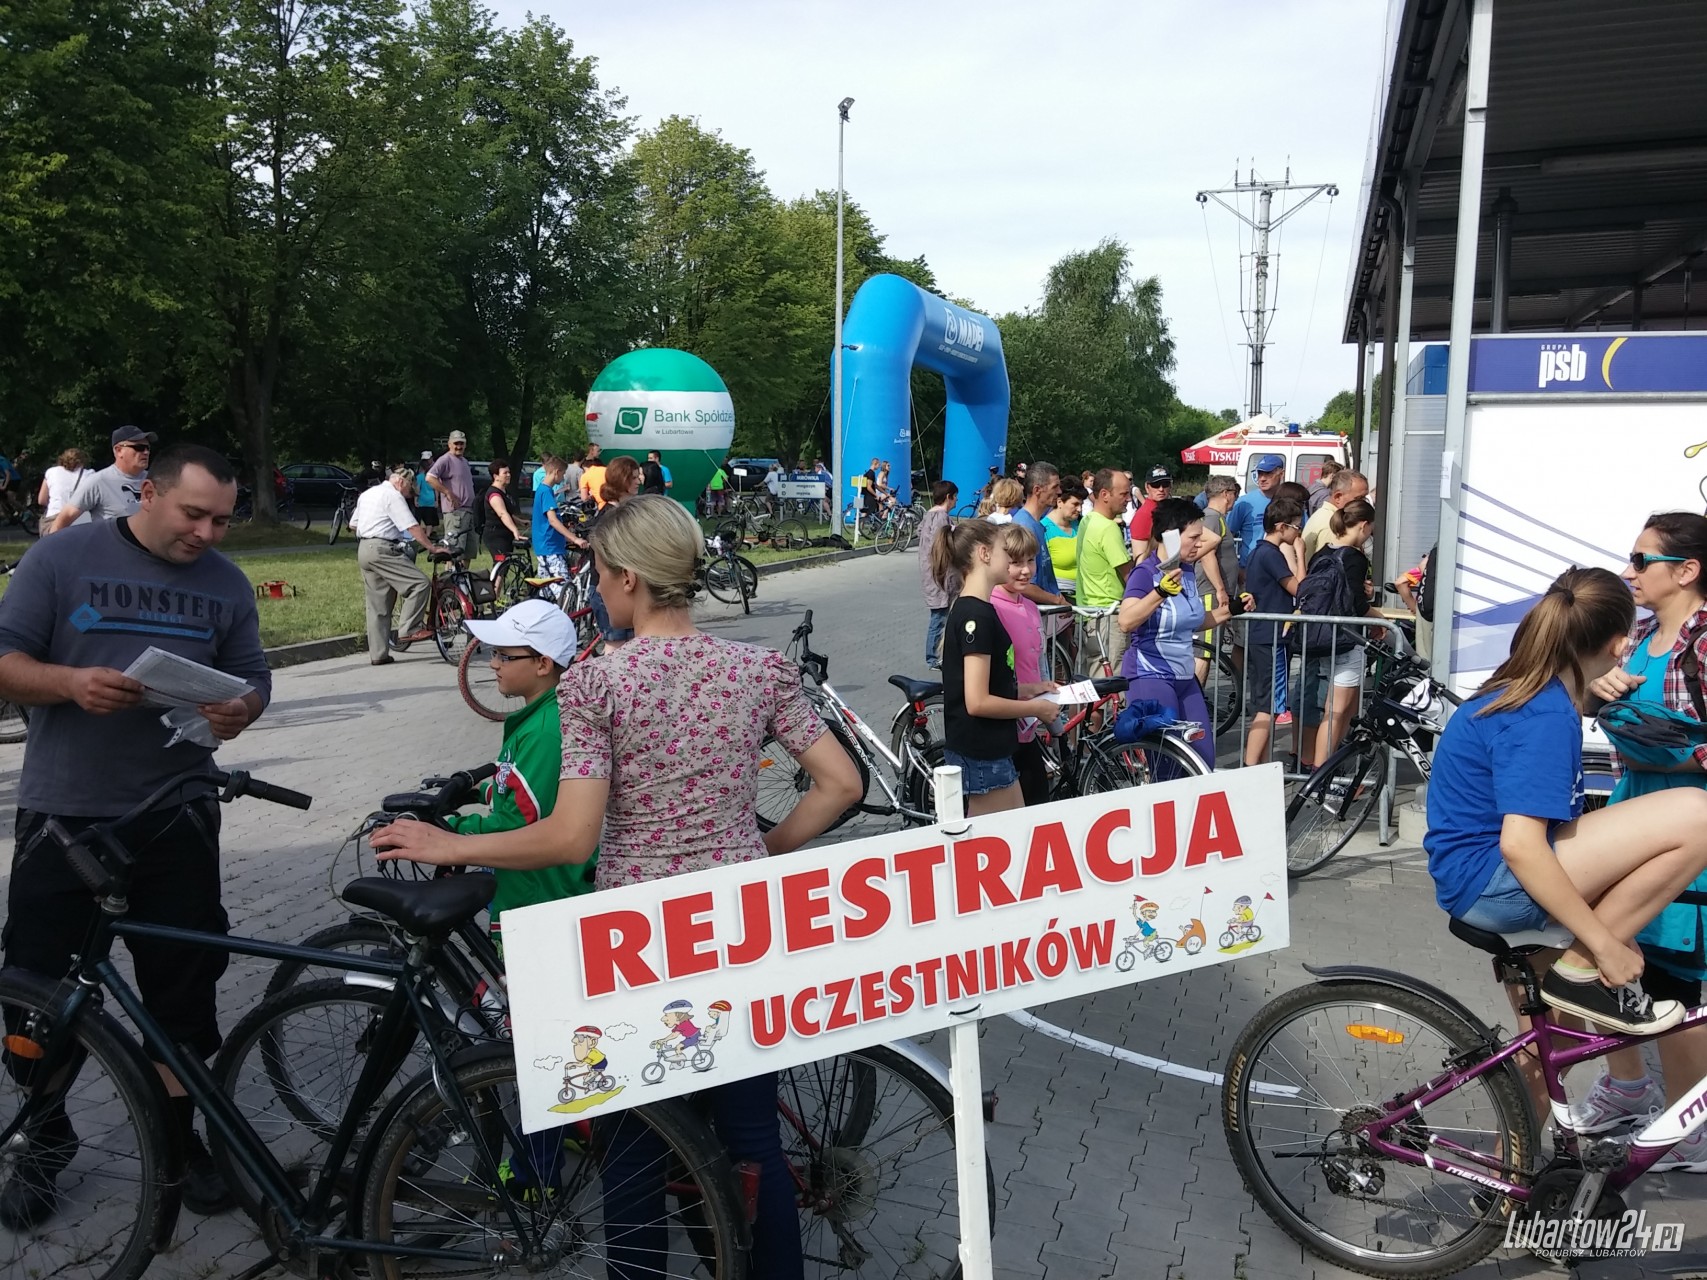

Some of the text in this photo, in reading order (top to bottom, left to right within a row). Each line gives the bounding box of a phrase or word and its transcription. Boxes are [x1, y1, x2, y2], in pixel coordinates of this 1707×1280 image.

[957, 317, 984, 352] MAPEI
[1539, 344, 1587, 388] psb
[654, 409, 691, 422] Bank
[89, 582, 224, 624] MONSTER
[137, 610, 185, 624] ENERGY
[579, 791, 1244, 997] REJESTRACJA
[750, 919, 1117, 1048] UCZESTNIKÓW
[1228, 1053, 1247, 1133] MERIDA
[1446, 1166, 1512, 1194] MERIDA
